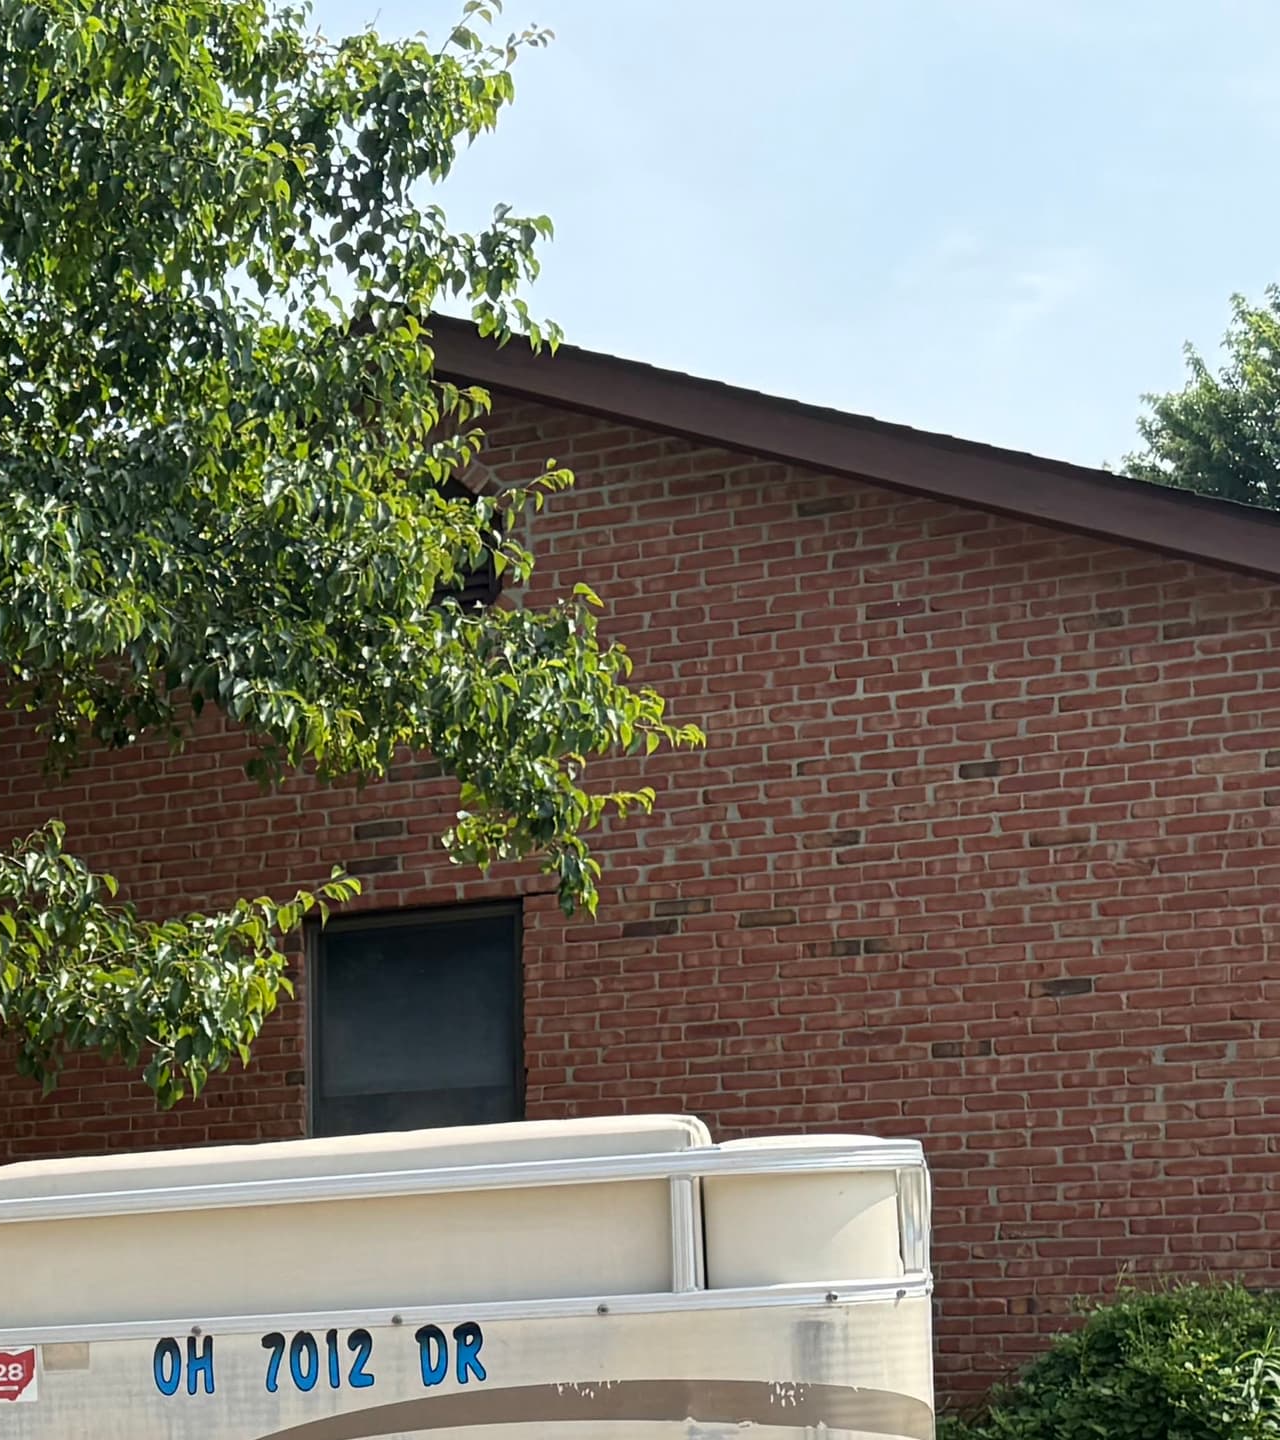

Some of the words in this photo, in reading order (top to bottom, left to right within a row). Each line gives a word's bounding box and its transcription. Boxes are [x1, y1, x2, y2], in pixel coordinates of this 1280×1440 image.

[153, 1335, 215, 1396] OH
[261, 1328, 375, 1393] 7012
[415, 1321, 487, 1387] DR
